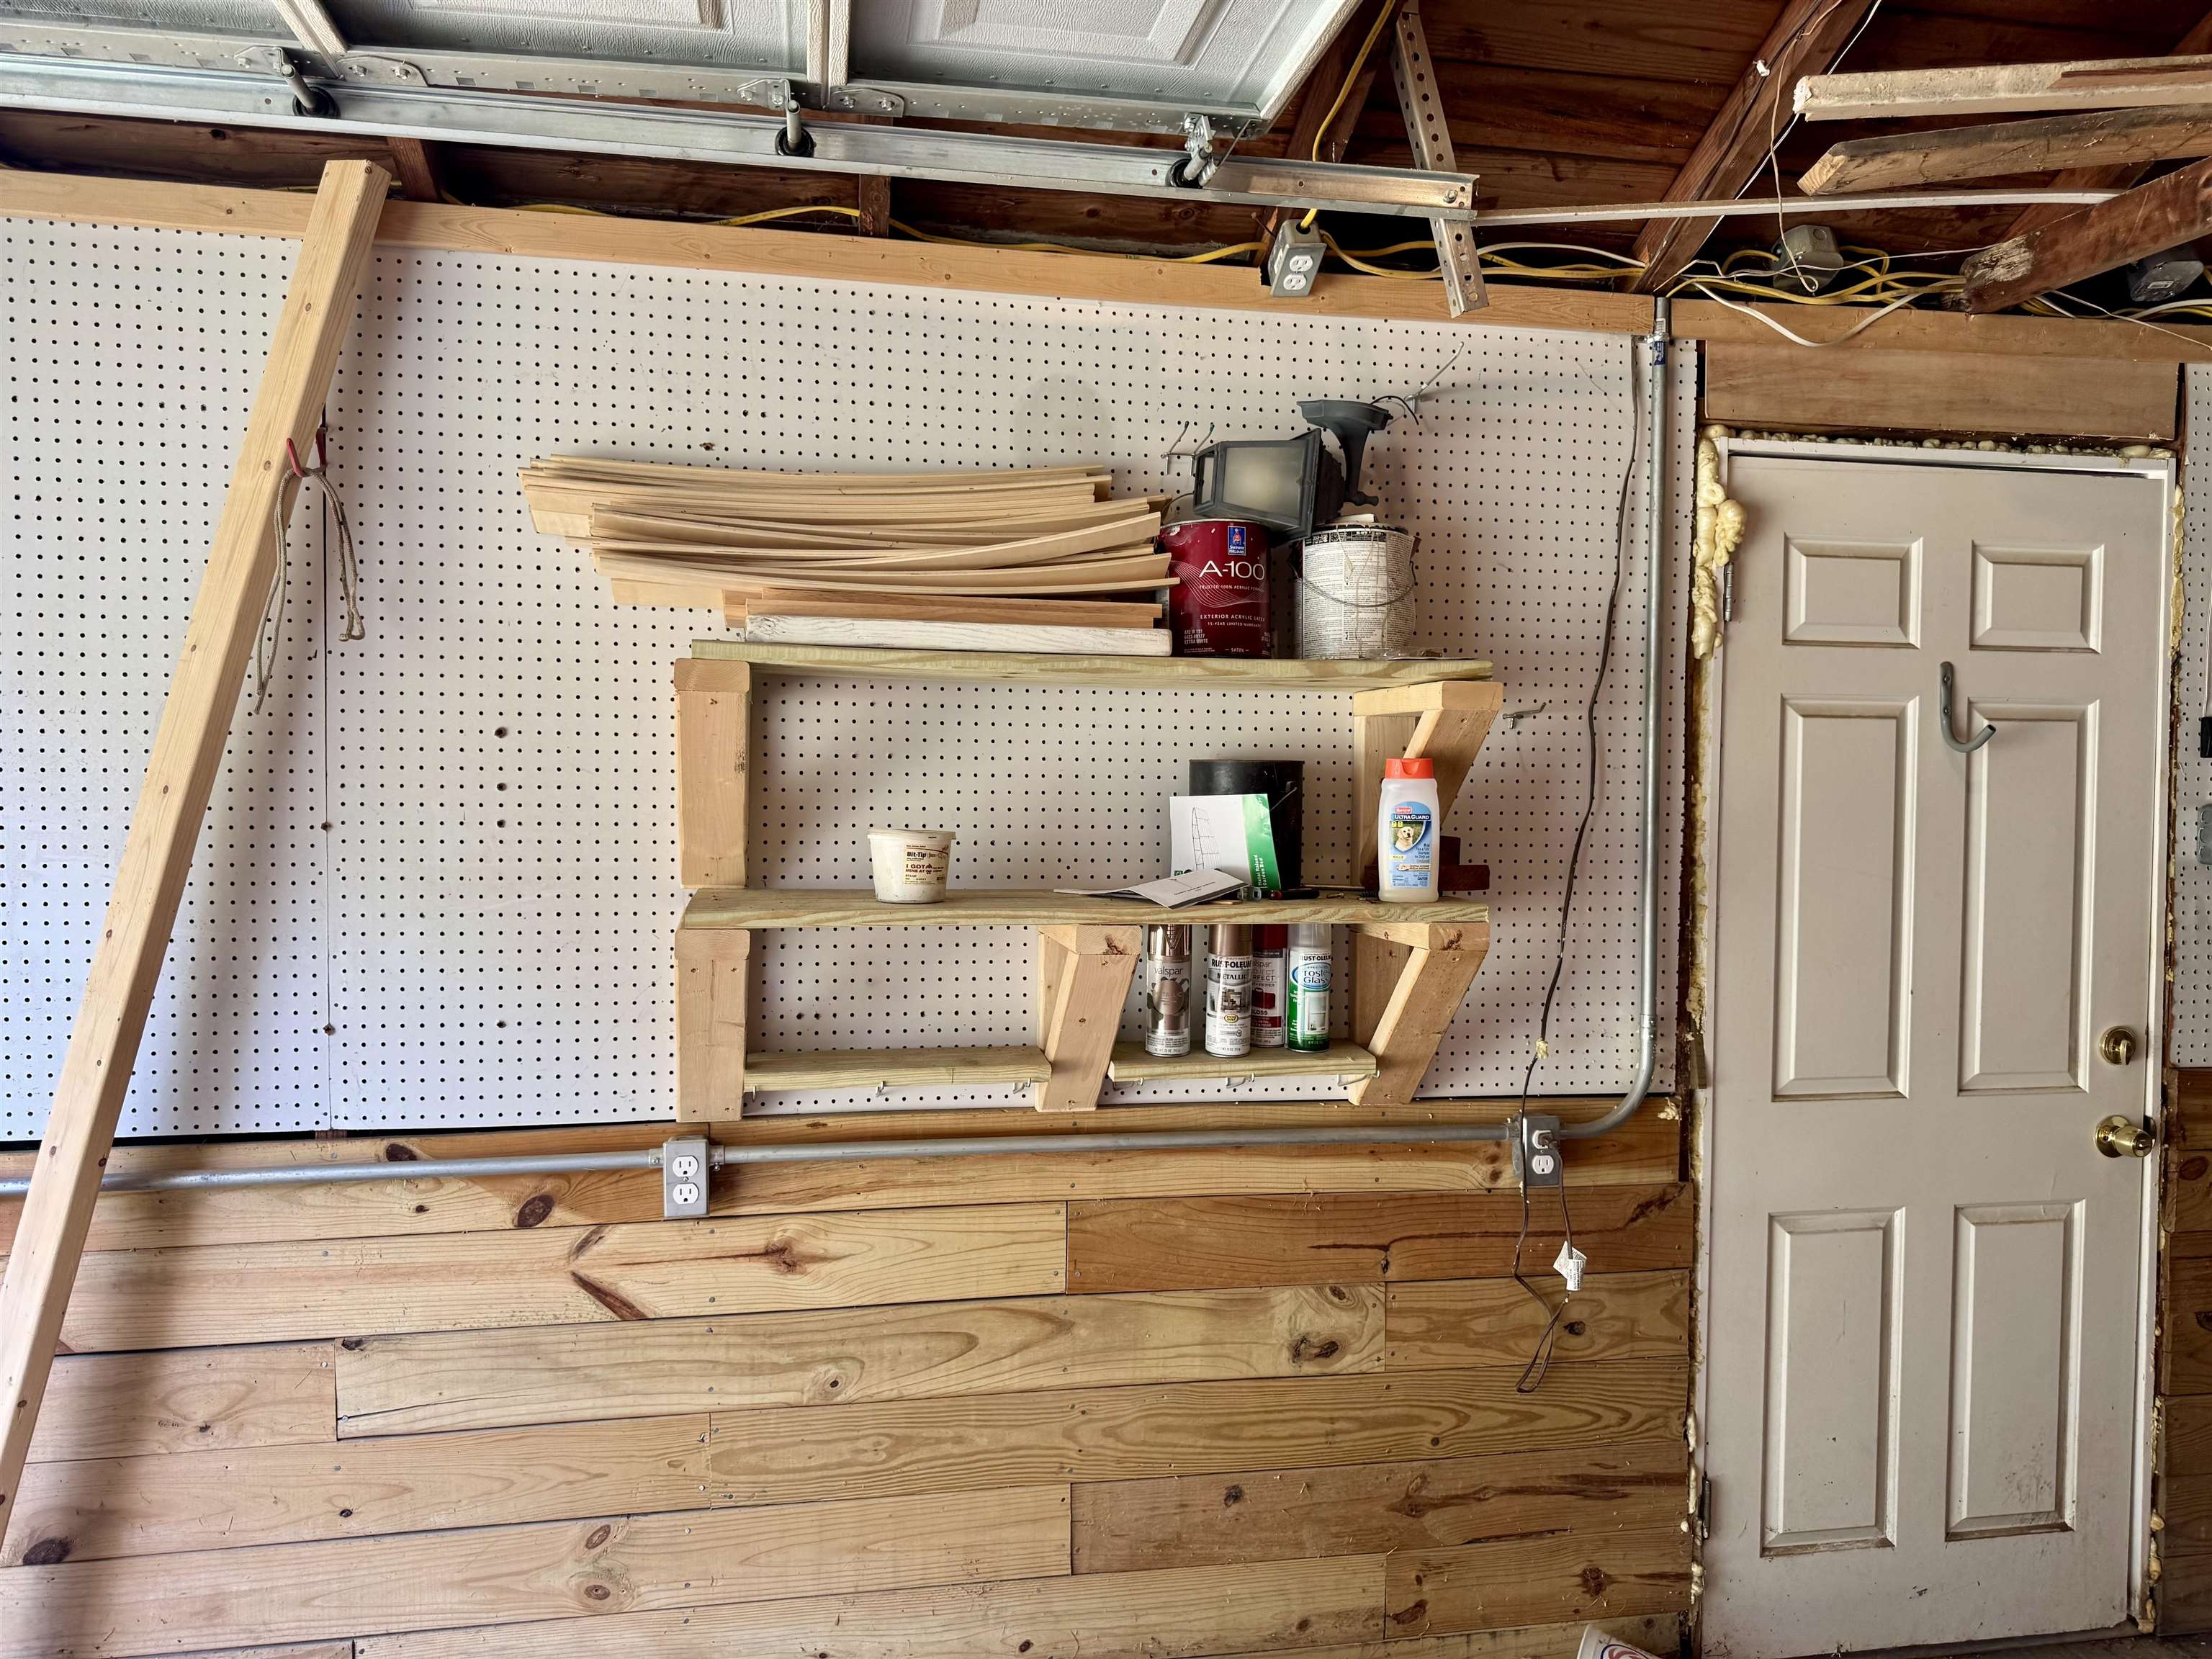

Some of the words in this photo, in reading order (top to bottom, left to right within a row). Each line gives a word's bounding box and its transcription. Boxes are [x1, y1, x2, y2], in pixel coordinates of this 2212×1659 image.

[1199, 560, 1265, 580] A-100
[1211, 958, 1252, 968] RUST-OLEUM
[1154, 966, 1184, 977] valspar
